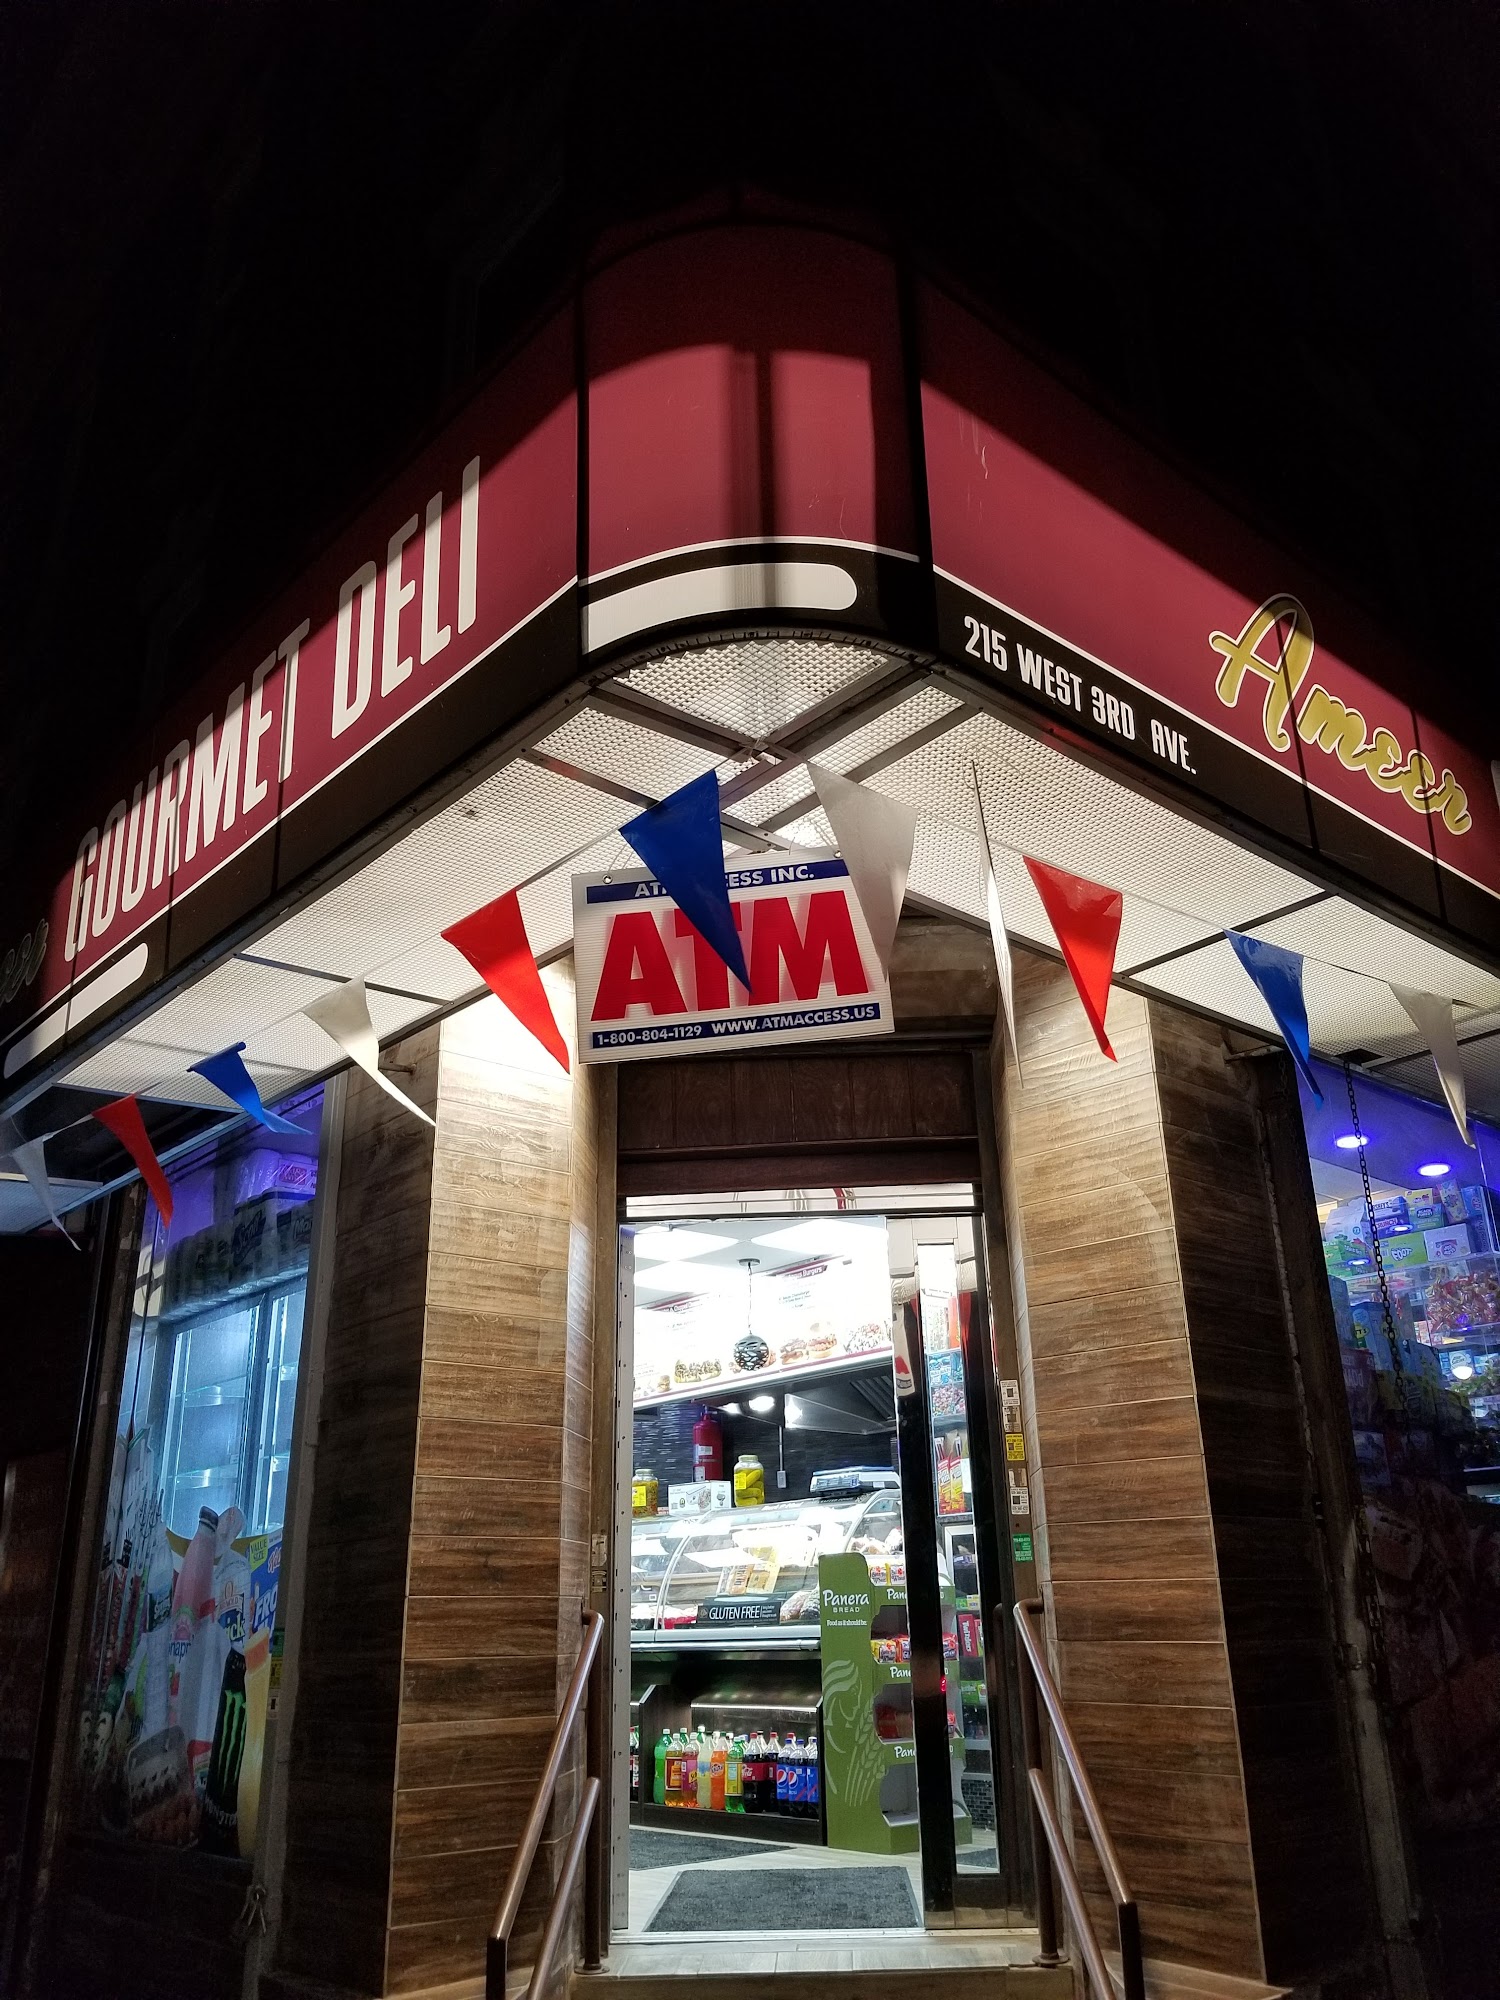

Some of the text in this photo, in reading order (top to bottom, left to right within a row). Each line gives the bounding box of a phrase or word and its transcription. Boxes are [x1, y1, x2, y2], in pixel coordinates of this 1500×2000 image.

[63, 617, 309, 963] GOURMET
[331, 455, 480, 740] DELI
[963, 615, 1198, 774] 215 WEST 3RD AVE.
[770, 865, 815, 882] INC.
[590, 890, 870, 1022] ATM
[597, 1005, 876, 1046] 1-800-804-1129 WWW.ATMACCESS.US
[709, 1606, 741, 1620] GLUTEN
[740, 1605, 761, 1619] FREE
[822, 1589, 870, 1607] Panera
